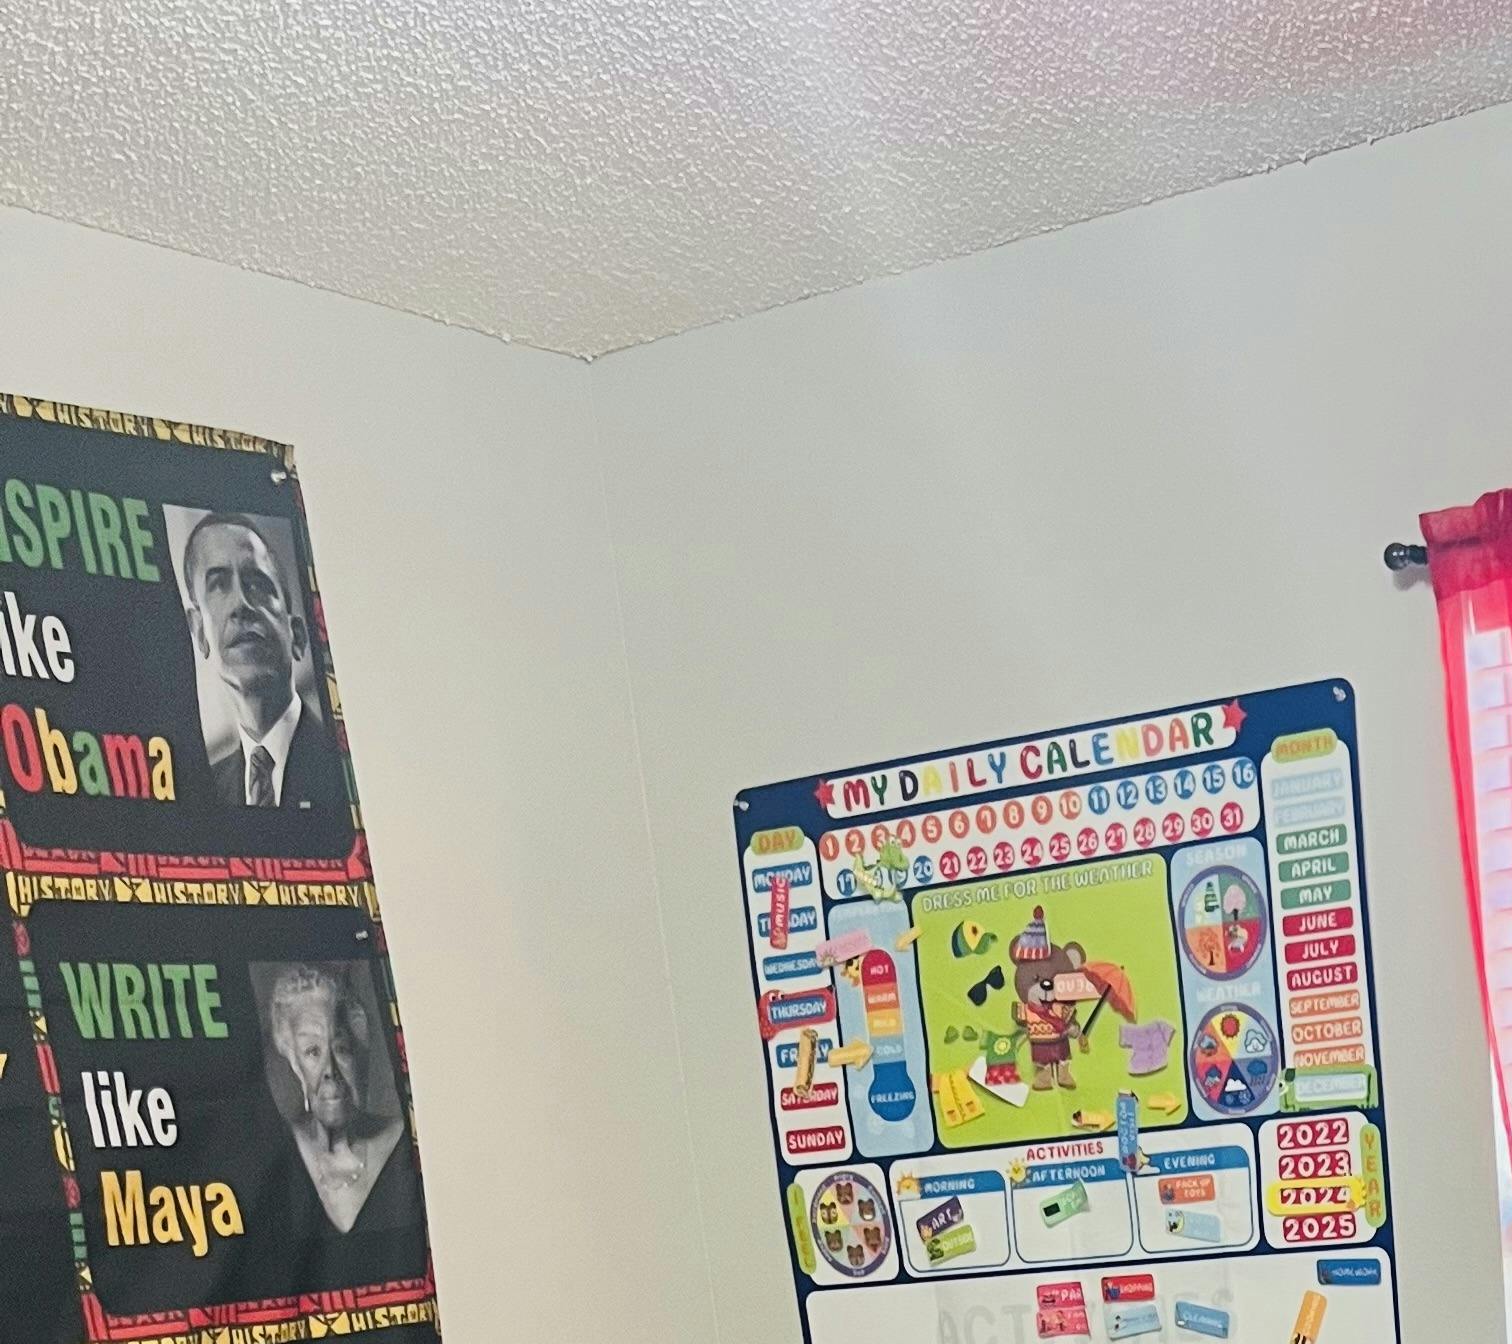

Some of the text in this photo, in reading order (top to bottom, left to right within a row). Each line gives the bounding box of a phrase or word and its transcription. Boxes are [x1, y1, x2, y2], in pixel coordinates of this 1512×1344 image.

[57, 402, 149, 438] HISTORY
[0, 478, 160, 582] SPIRE
[1, 703, 176, 801] Obama
[1275, 736, 1333, 755] MONTH
[842, 711, 1214, 812] MY DAILY CALENDAR
[1272, 772, 1342, 797] JANUARY
[850, 834, 861, 854] 2
[900, 824, 914, 845] 4
[925, 820, 938, 839] 5
[952, 815, 965, 834] 6
[979, 811, 991, 830] 7
[1008, 806, 1020, 825] 8
[1036, 801, 1048, 820] 9
[1061, 796, 1080, 816] 10
[1090, 792, 1109, 810] 11
[1119, 787, 1137, 805] 12
[1147, 782, 1166, 799] 13
[1175, 776, 1195, 795] 14
[1204, 771, 1224, 790] 15
[1234, 765, 1254, 784] 16
[1274, 801, 1345, 825] FEBRUARY
[758, 830, 796, 850] DAY
[914, 860, 932, 880] 20
[942, 856, 959, 875] 21
[968, 851, 986, 870] 22
[995, 847, 1013, 865] 23
[1022, 842, 1041, 862] 24
[1050, 837, 1069, 857] 25
[1078, 834, 1097, 851] 26
[1107, 829, 1126, 846] 27
[1135, 824, 1155, 841] 28
[1164, 819, 1183, 836] 29
[1192, 814, 1212, 831] 30
[1223, 808, 1242, 826] 31
[1283, 830, 1340, 850] MARCH
[1184, 845, 1247, 867] SEASON
[1291, 858, 1337, 878] APRIL
[18, 873, 360, 908] HISTORY HISTORY HISTORY
[922, 889, 972, 912] DRESS
[976, 886, 1000, 903] ME
[1003, 879, 1038, 899] FOR
[1042, 875, 1070, 893] THE
[1074, 861, 1154, 887] WEATHER
[1299, 885, 1333, 904] MAY
[773, 877, 788, 930] MUSIC
[759, 912, 817, 934] TDAY
[1298, 914, 1337, 932] JUNE
[1302, 941, 1340, 960] JULY
[1291, 967, 1353, 987] AUGUST
[59, 961, 230, 1041] WRITE
[1196, 981, 1261, 1002] WEATHER
[770, 1001, 827, 1020] THURSDAY
[1289, 992, 1360, 1015] SEPTEMBER
[1292, 1020, 1362, 1041] OCTOBER
[1294, 1047, 1365, 1067] NOVEMBER
[81, 1070, 178, 1149] like
[788, 1131, 843, 1150] SUNDAY
[1278, 1120, 1348, 1149] 2022
[1025, 1142, 1104, 1161] ACTIVITIES
[1163, 1154, 1216, 1170] EVENING
[1030, 1165, 1106, 1183] AFTERNOON
[1280, 1152, 1350, 1179] 2023
[1363, 1133, 1382, 1218] YEAR
[924, 1178, 975, 1194] MORNING
[1282, 1187, 1351, 1206] 2024
[100, 1171, 245, 1257] Maya
[1284, 1214, 1356, 1241] 2025
